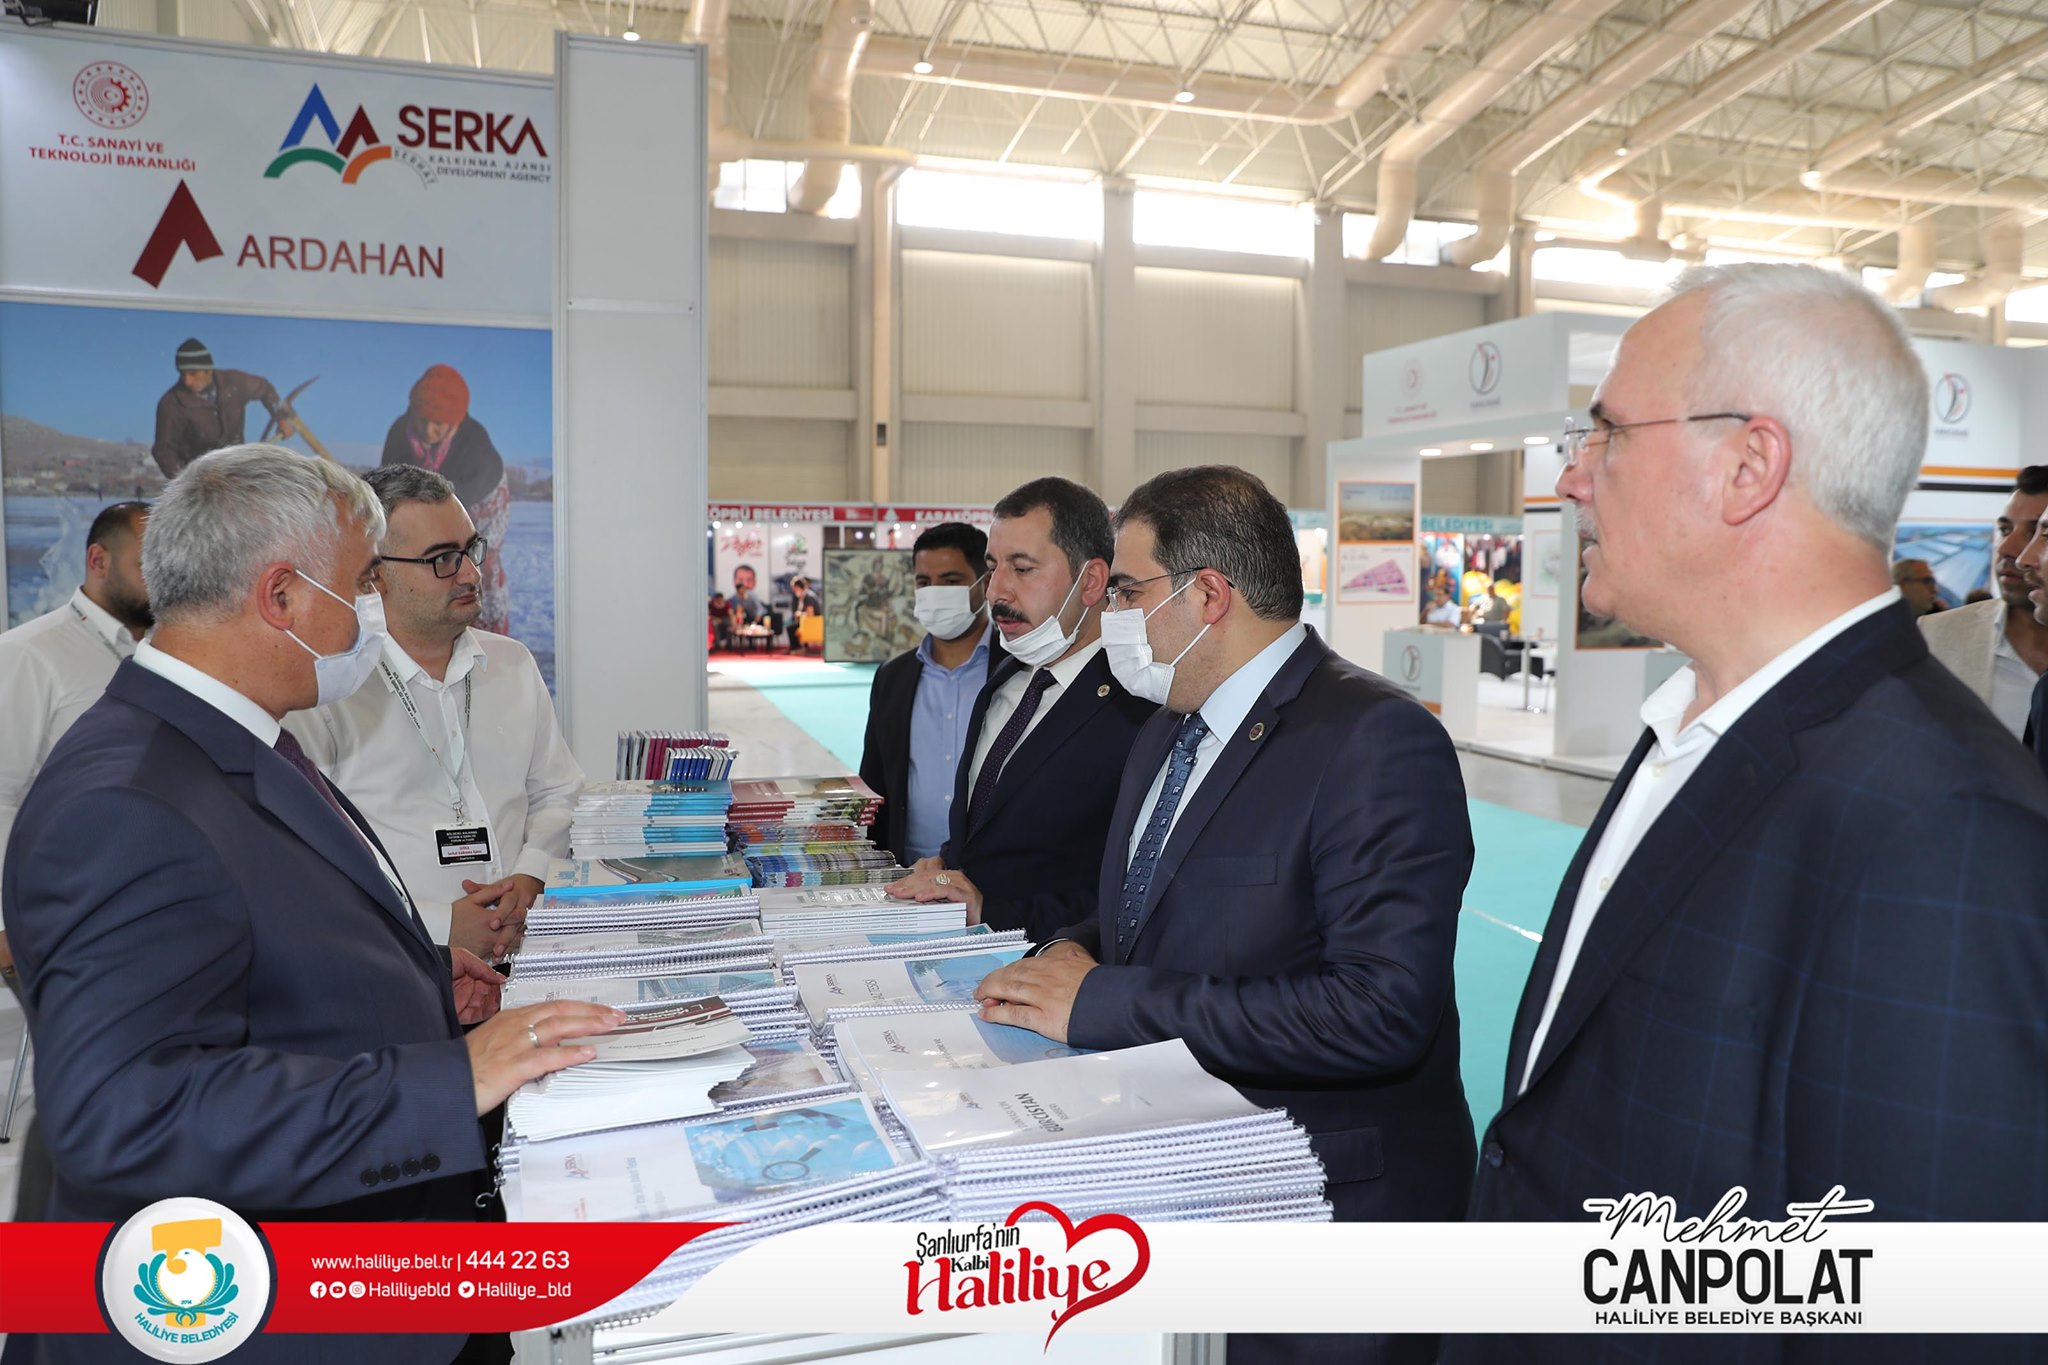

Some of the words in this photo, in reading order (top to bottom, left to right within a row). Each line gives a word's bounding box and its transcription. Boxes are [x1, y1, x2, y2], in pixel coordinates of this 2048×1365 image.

[397, 104, 548, 158] SERKA
[58, 133, 84, 147] T.C.
[87, 136, 142, 151] SANAYİ
[145, 142, 164, 153] VE
[29, 147, 112, 165] TEKNOLOJİ
[116, 154, 197, 172] BAKANLIĞI
[429, 155, 498, 168] KALKINMA
[436, 166, 508, 181] DEVELOPMENT
[509, 172, 552, 184] AGENCY
[236, 234, 444, 279] ARDAHAN
[708, 504, 749, 520] ÖPRÜ
[753, 505, 834, 520] BELEDİYESİ
[915, 507, 994, 522] KARAKÖPR
[1015, 1092, 1064, 1133] GÜRCİSTAN
